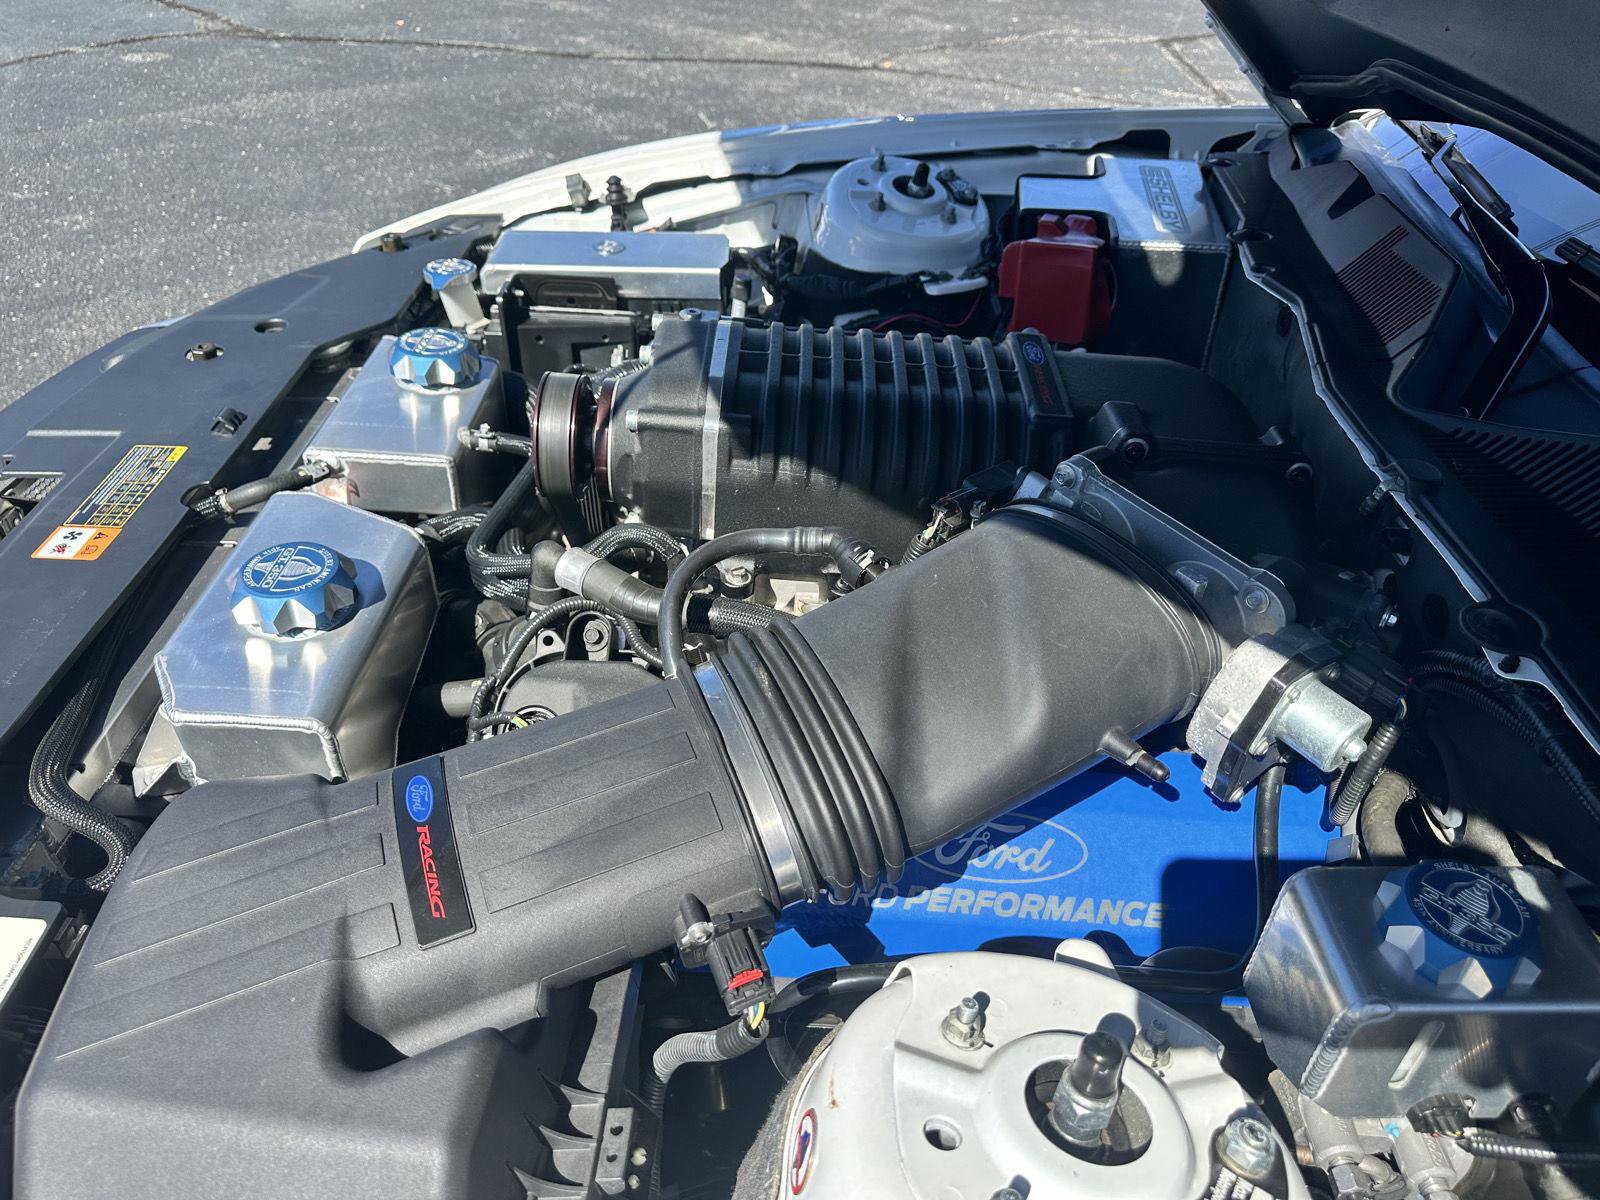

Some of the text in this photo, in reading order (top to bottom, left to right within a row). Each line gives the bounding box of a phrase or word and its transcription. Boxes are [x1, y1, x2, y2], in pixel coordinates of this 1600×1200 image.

[1147, 175, 1185, 231] SHELBY
[410, 783, 429, 812] Ford
[416, 825, 446, 918] RACING
[935, 822, 1055, 873] Ford
[806, 882, 1168, 929] RD PERFORMANCE
